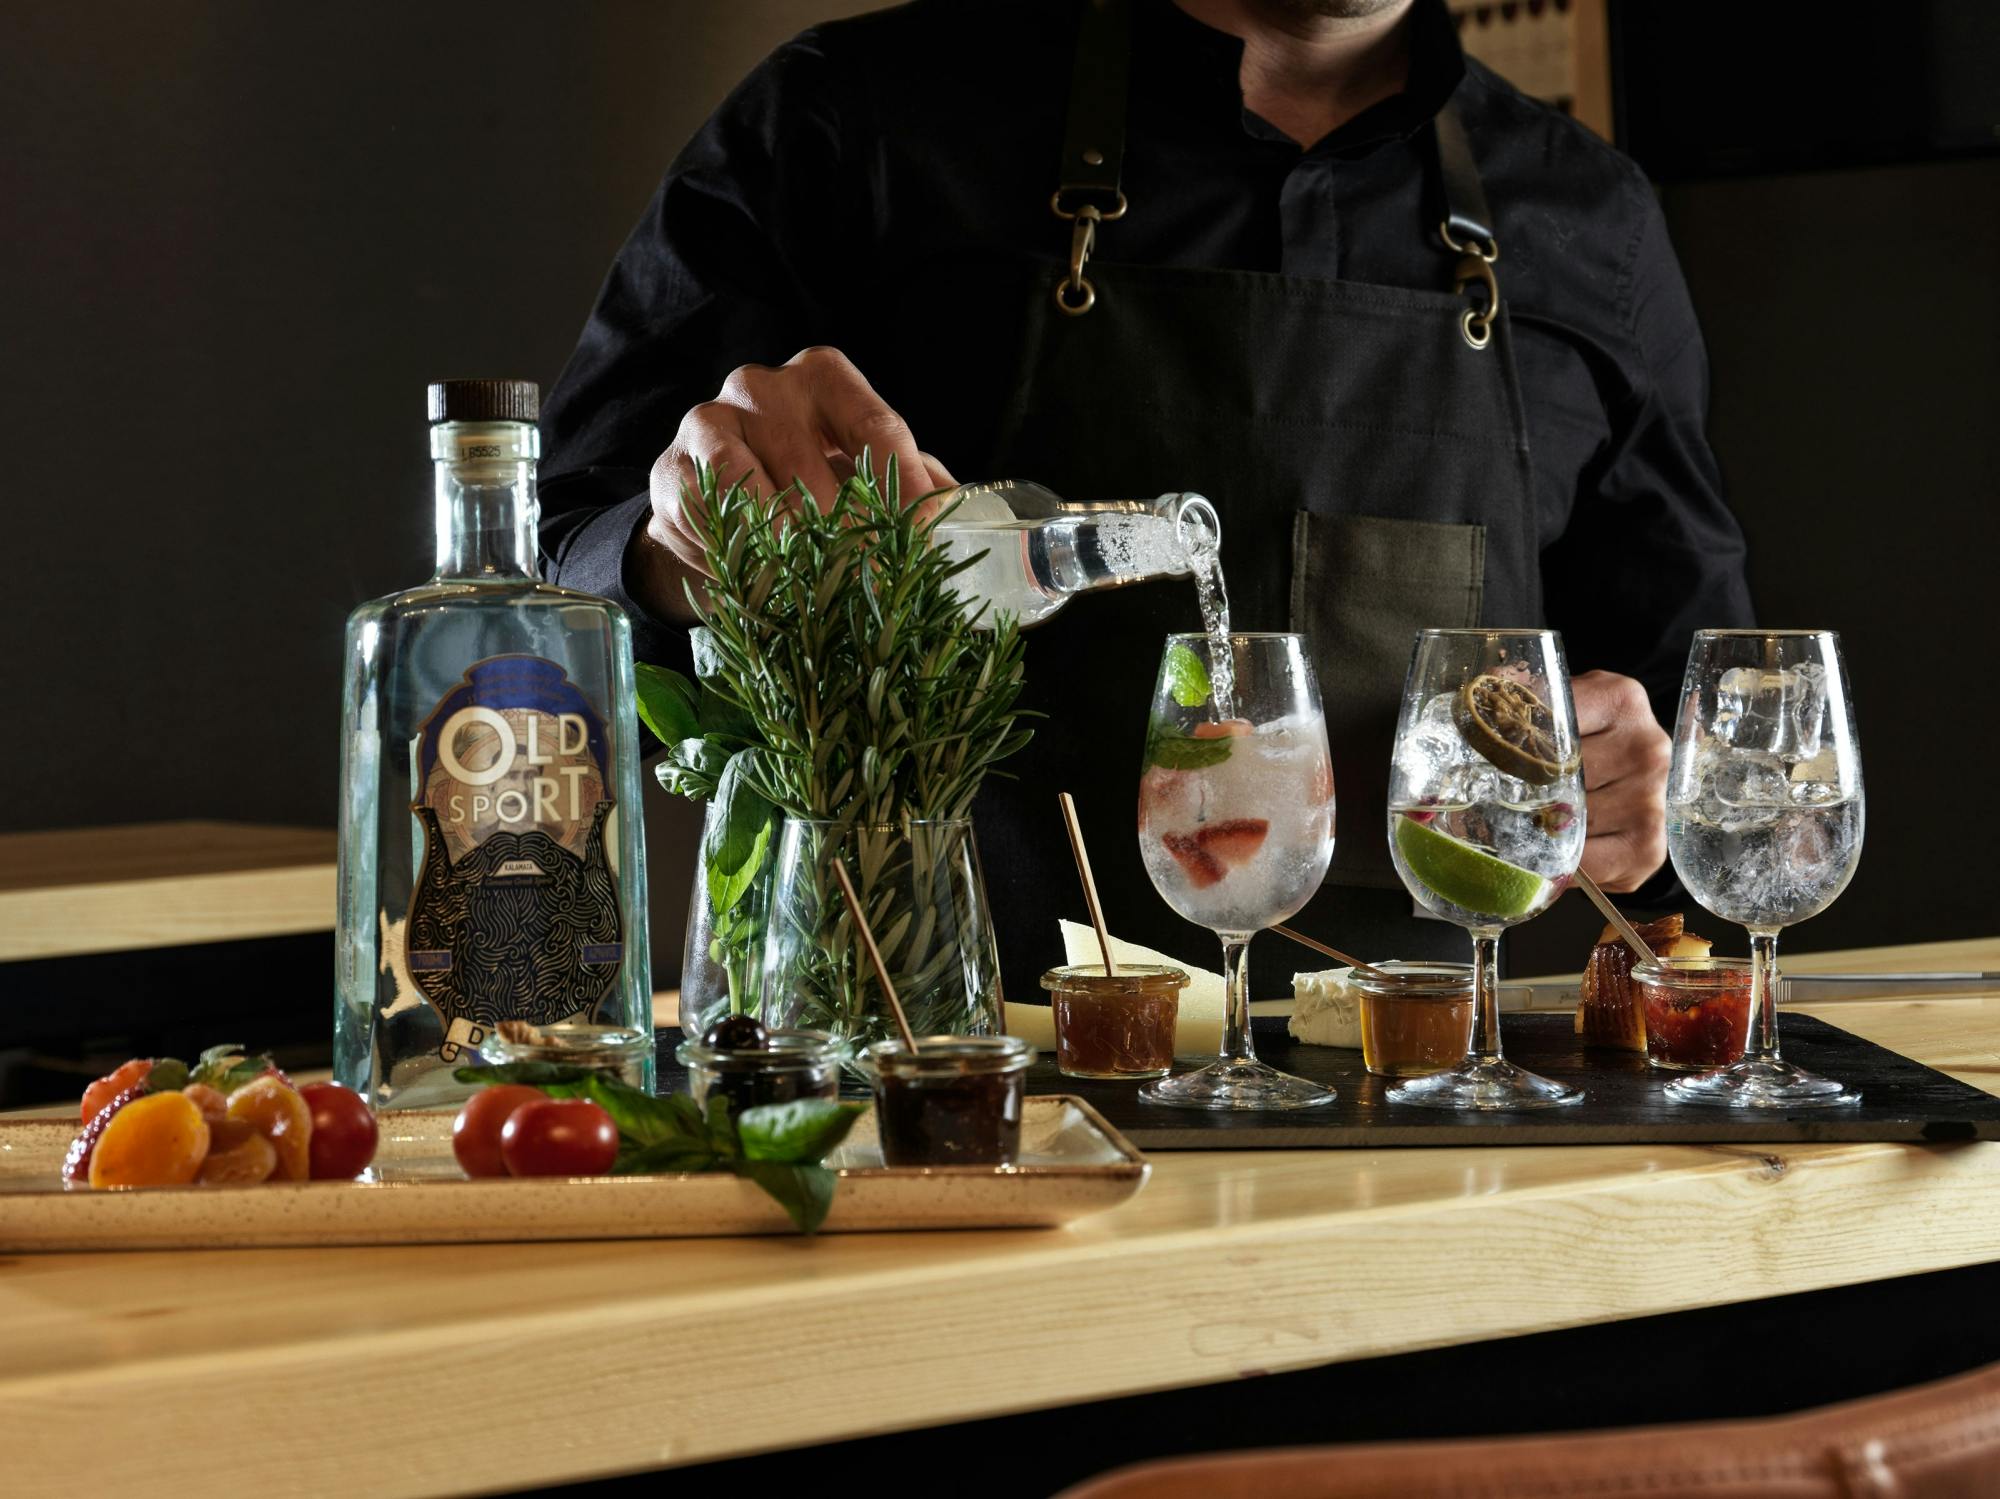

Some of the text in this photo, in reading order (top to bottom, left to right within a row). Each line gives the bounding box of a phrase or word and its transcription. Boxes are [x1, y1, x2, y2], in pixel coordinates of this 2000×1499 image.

[438, 706, 589, 786] OLD
[450, 766, 589, 823] SPORT
[504, 863, 533, 871] KALAMATA
